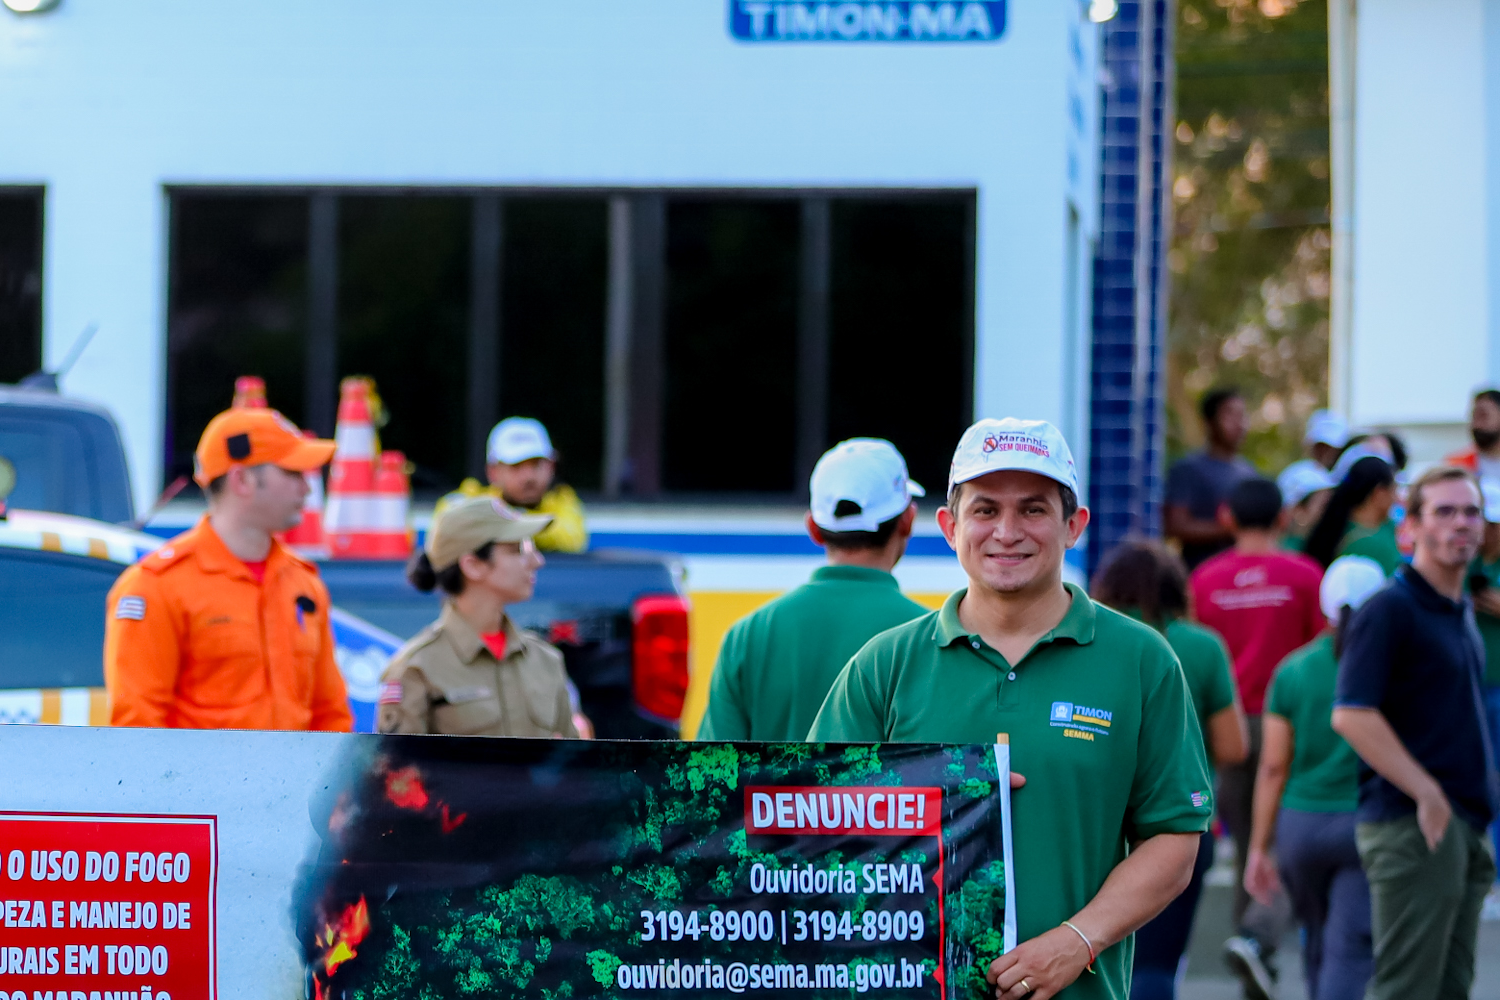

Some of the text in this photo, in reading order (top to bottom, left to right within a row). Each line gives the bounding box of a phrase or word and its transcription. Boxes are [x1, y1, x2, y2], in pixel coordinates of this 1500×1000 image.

[740, 1, 993, 39] TIMON-MA
[1075, 705, 1112, 721] TIMON
[1063, 728, 1094, 741] SEMMA
[751, 792, 926, 830] DENUNCIE!
[7, 849, 25, 881] O
[30, 850, 79, 881] USO
[84, 850, 120, 882] DO
[125, 851, 191, 883] FOGO
[750, 863, 925, 894] Ouvidoria SEMA
[52, 901, 65, 928] E
[69, 901, 157, 929] MANEJO
[163, 902, 191, 929] DE
[640, 910, 774, 941] 3194-8900
[793, 910, 925, 941] 3194-8909
[64, 944, 99, 975] EM
[104, 945, 169, 975] TODO
[617, 958, 925, 992] ouvidoria@sema.ma.gov.br
